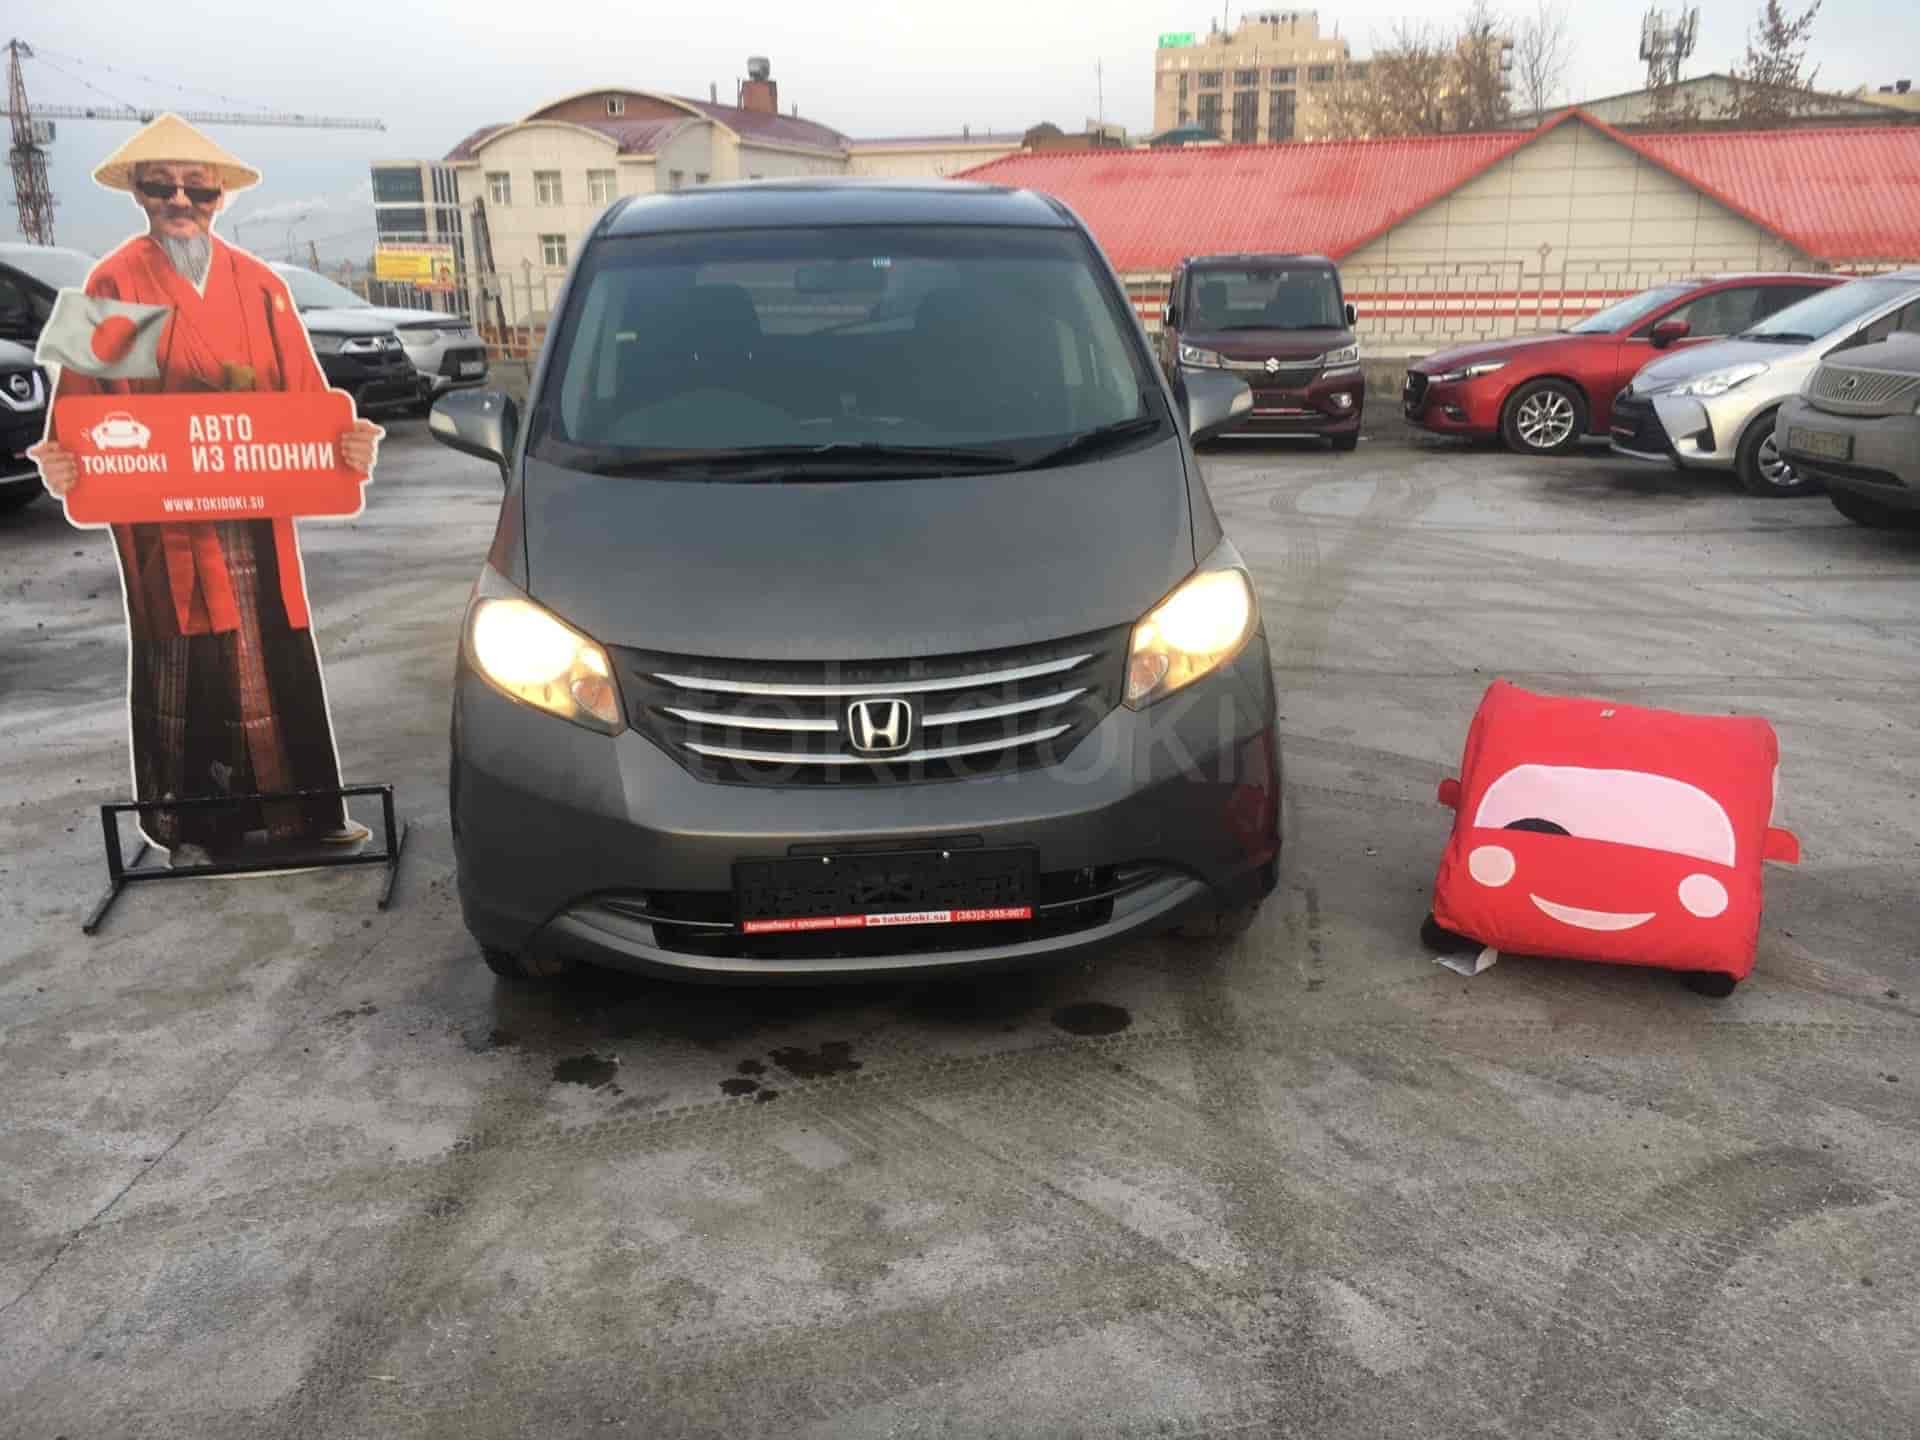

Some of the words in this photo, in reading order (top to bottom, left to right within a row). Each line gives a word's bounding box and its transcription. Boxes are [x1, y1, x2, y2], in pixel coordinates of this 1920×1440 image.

[188, 414, 254, 443] АВТО
[81, 453, 168, 475] TOKIDOKI
[191, 444, 225, 473] ИЗ
[233, 442, 336, 472] ЯПОНИИ
[162, 495, 265, 513] WWW.TOKIDOKI.SU
